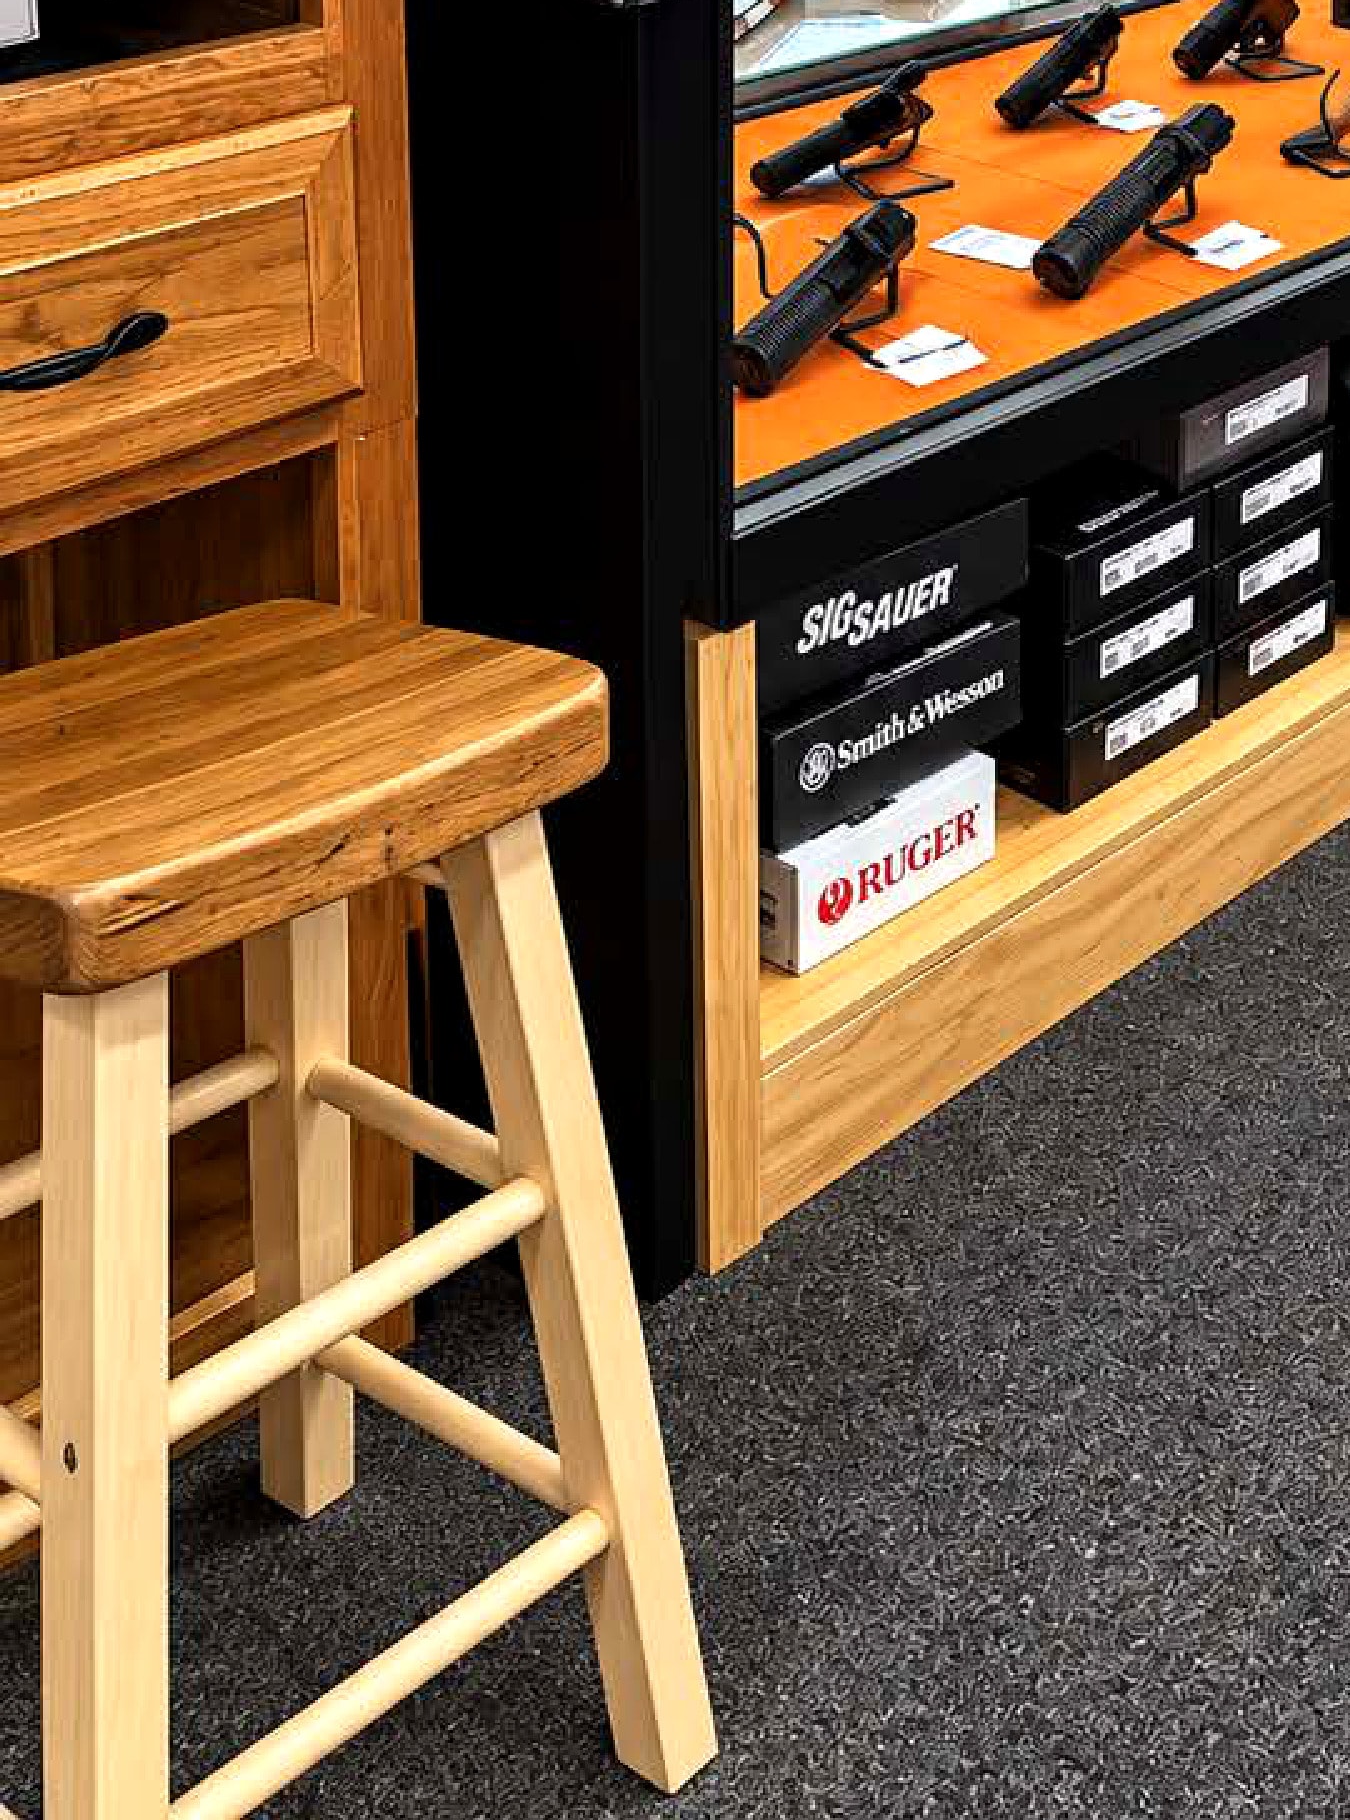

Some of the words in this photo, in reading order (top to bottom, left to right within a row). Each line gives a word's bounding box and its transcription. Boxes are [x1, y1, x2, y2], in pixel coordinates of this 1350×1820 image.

[838, 712, 906, 769] Smith
[925, 669, 1004, 724] Wesson
[857, 806, 979, 905] RUGER
